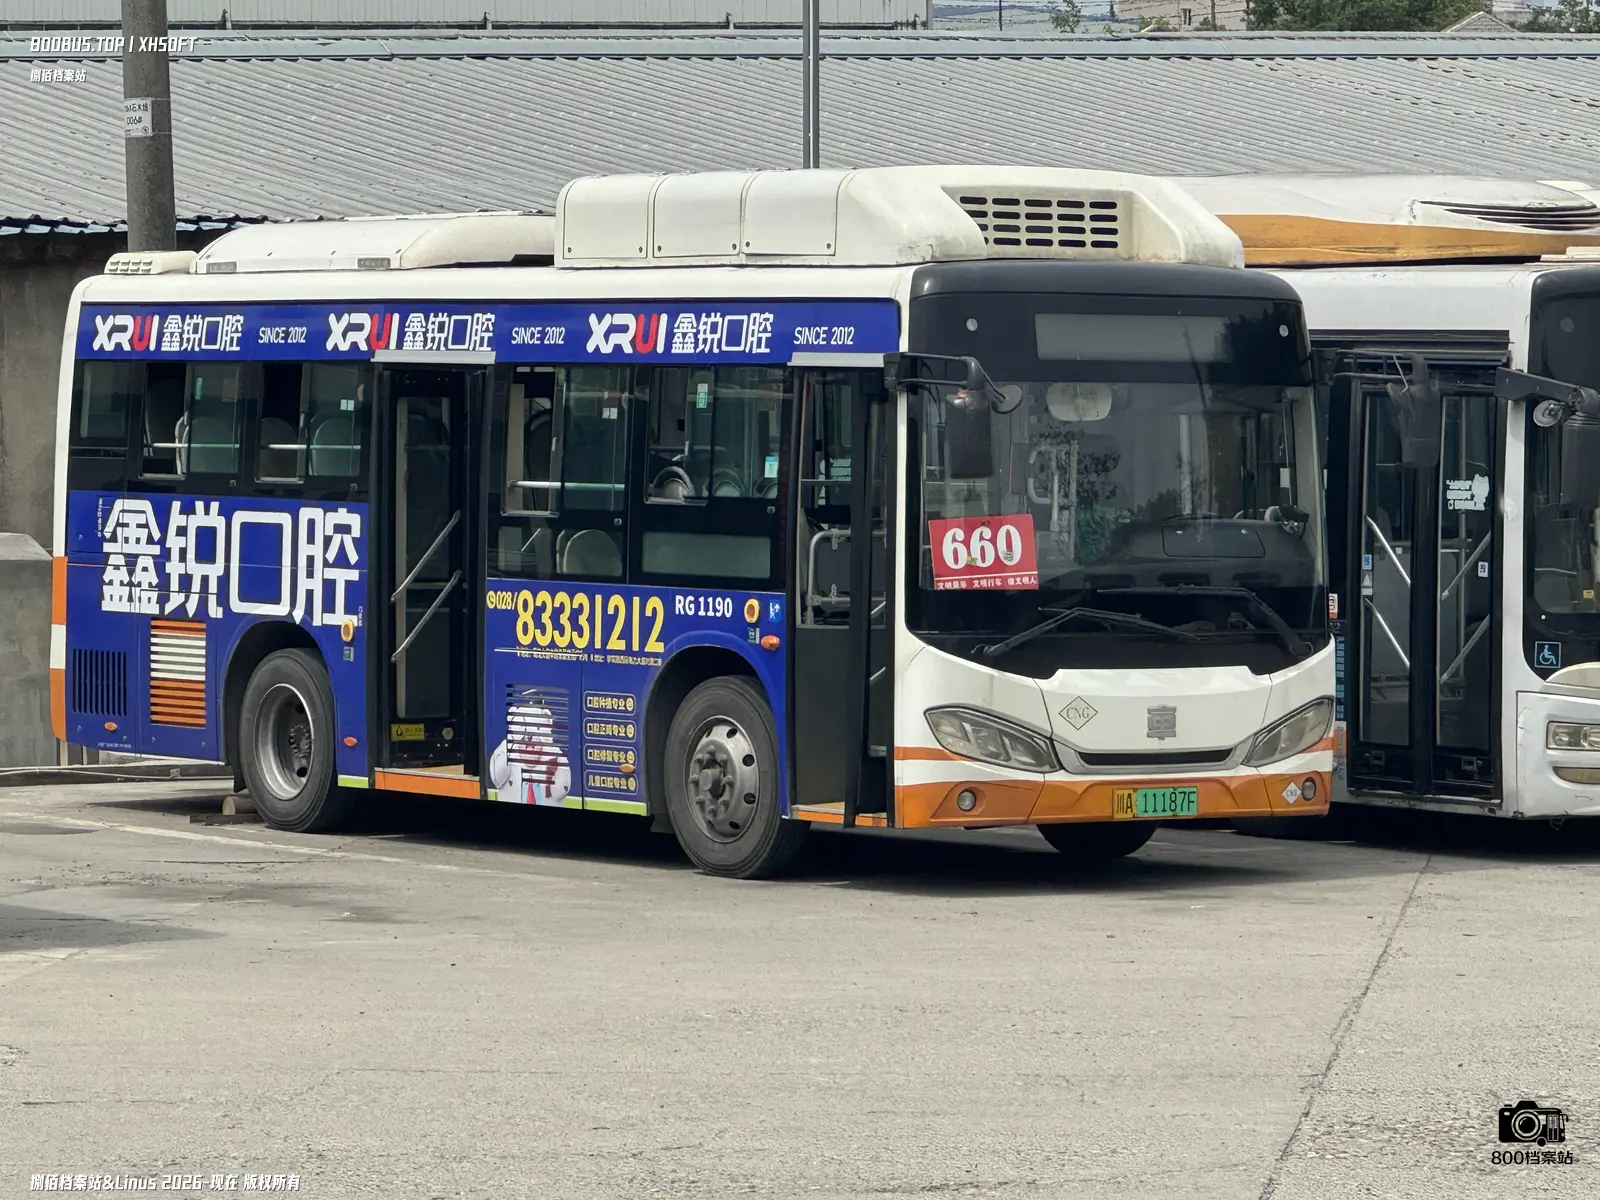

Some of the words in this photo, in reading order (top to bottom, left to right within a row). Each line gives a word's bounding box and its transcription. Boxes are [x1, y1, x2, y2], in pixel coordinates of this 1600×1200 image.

[161, 314, 245, 352] 鑫锐口腔
[258, 326, 287, 345] SINCE
[287, 326, 308, 344] 2012
[402, 312, 496, 352] 鑫锐口腔
[511, 326, 542, 345] SINCE
[543, 326, 566, 345] 2012
[671, 312, 775, 354] 鑫锐口腔
[793, 326, 829, 346] SINCE
[830, 326, 856, 346] 2012
[942, 524, 1022, 570] 660
[101, 498, 361, 627] 鑫锐口腔
[675, 595, 695, 616] RG
[698, 597, 733, 618] 1190
[1066, 706, 1090, 720] CNG
[1142, 790, 1196, 813] 11187F
